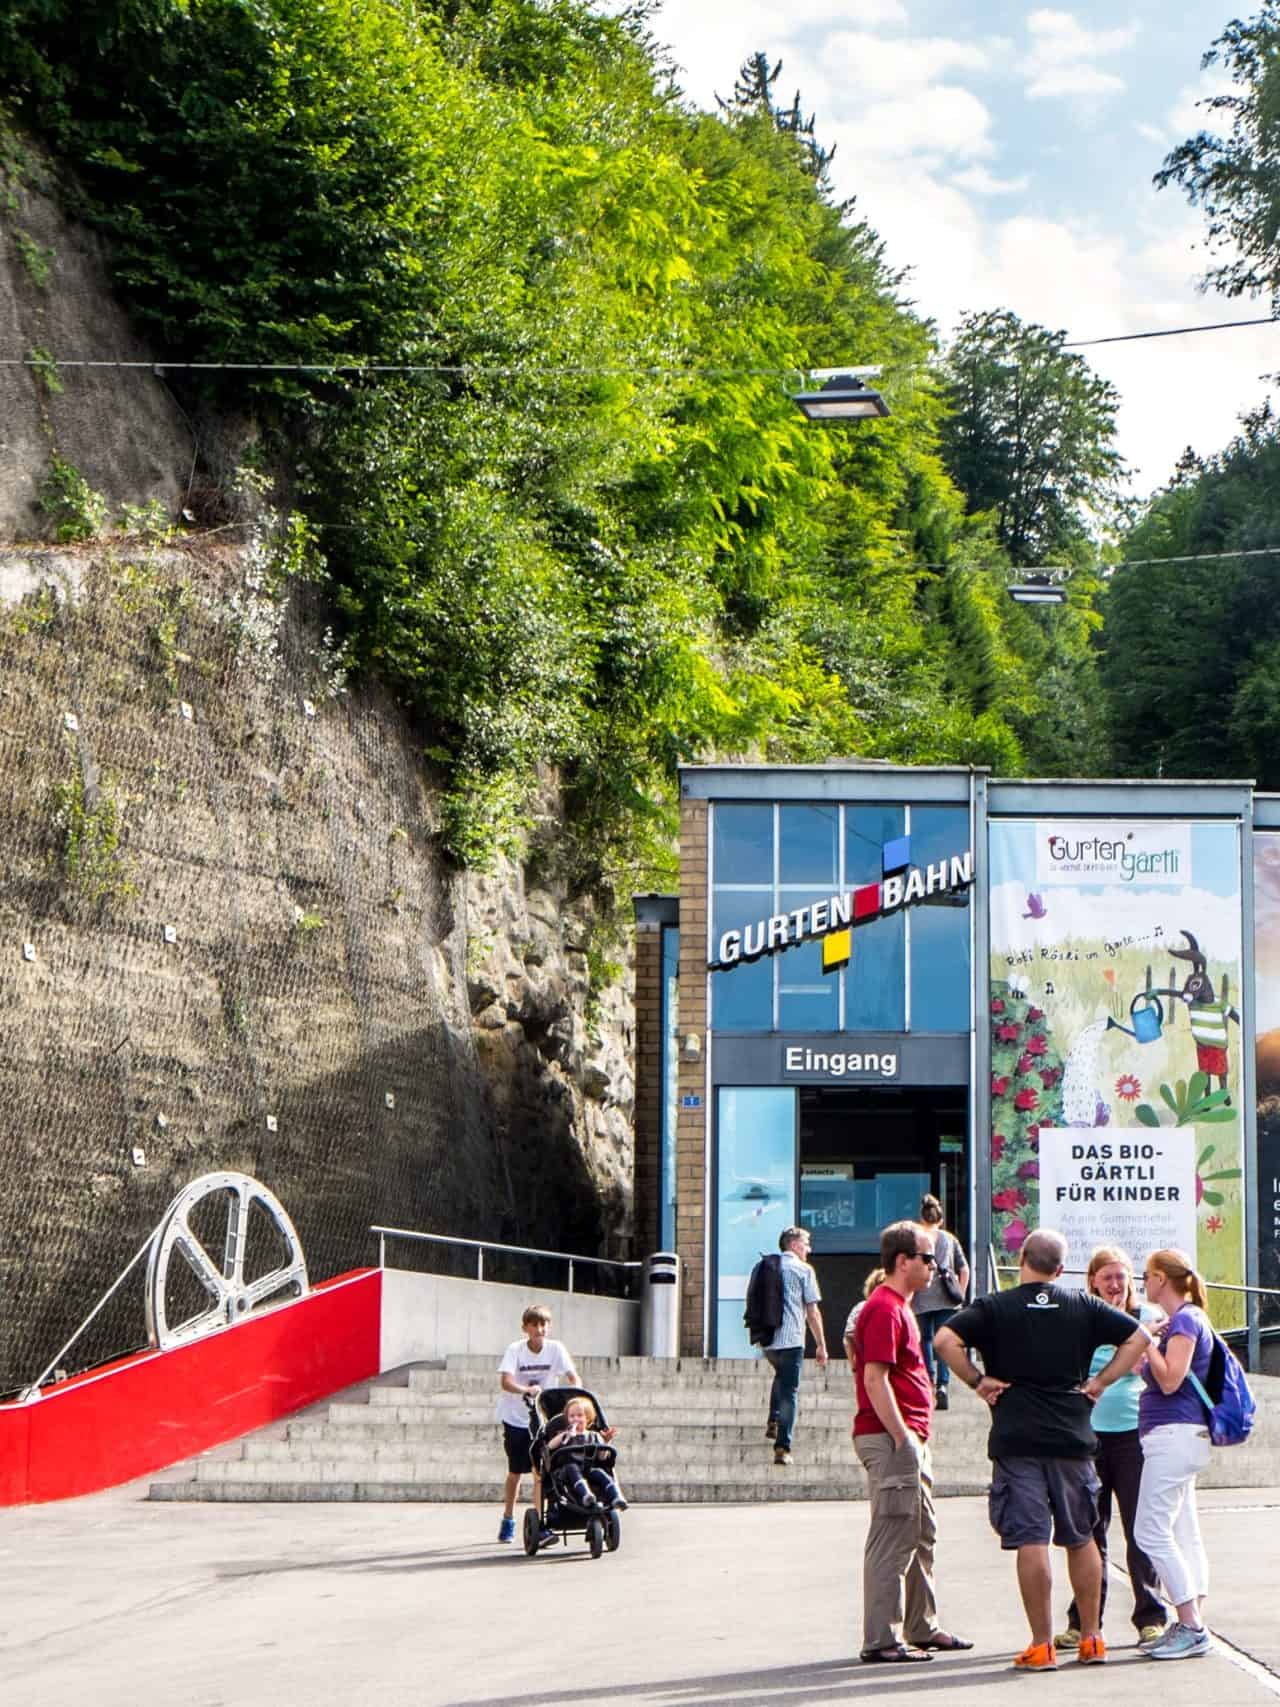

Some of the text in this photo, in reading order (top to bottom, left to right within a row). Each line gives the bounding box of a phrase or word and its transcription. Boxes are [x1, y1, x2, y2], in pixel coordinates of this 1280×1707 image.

[719, 851, 972, 964] GURTEN BAHN
[786, 1047, 898, 1077] Eingang
[1072, 1145, 1163, 1159] DAS BIO-
[1080, 1162, 1155, 1180] GÄRTLI
[1056, 1183, 1180, 1201] FÜR KINDER
